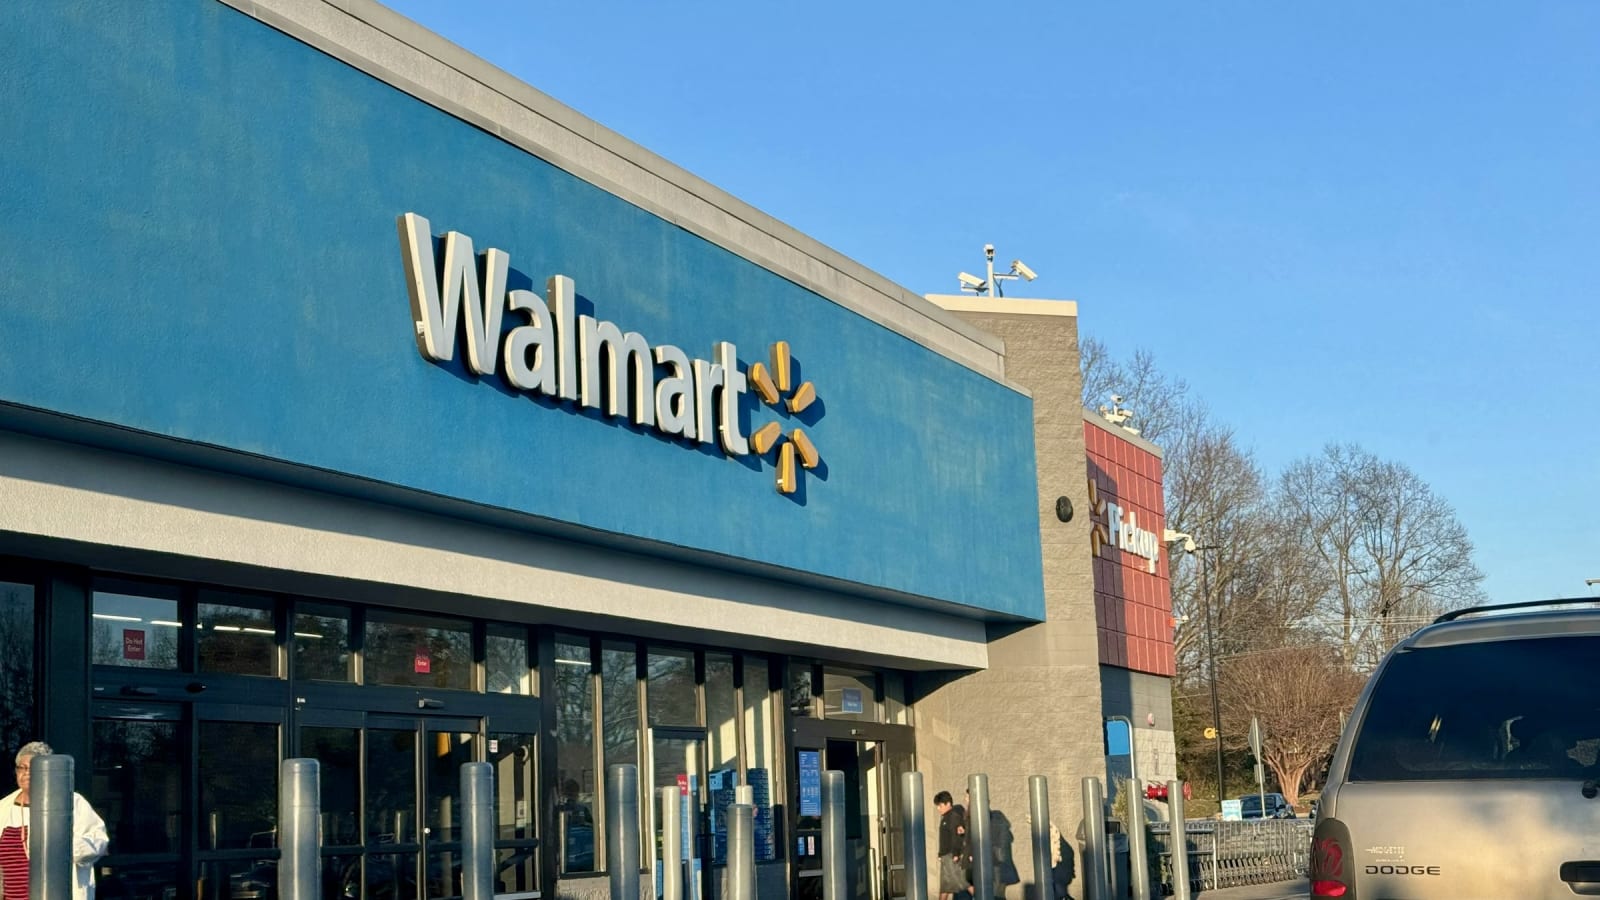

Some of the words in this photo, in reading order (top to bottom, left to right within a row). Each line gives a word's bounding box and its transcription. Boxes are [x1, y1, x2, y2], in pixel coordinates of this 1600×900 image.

[400, 212, 749, 456] Walmart
[1107, 502, 1159, 574] Pickup
[1365, 865, 1441, 876] DODGE
